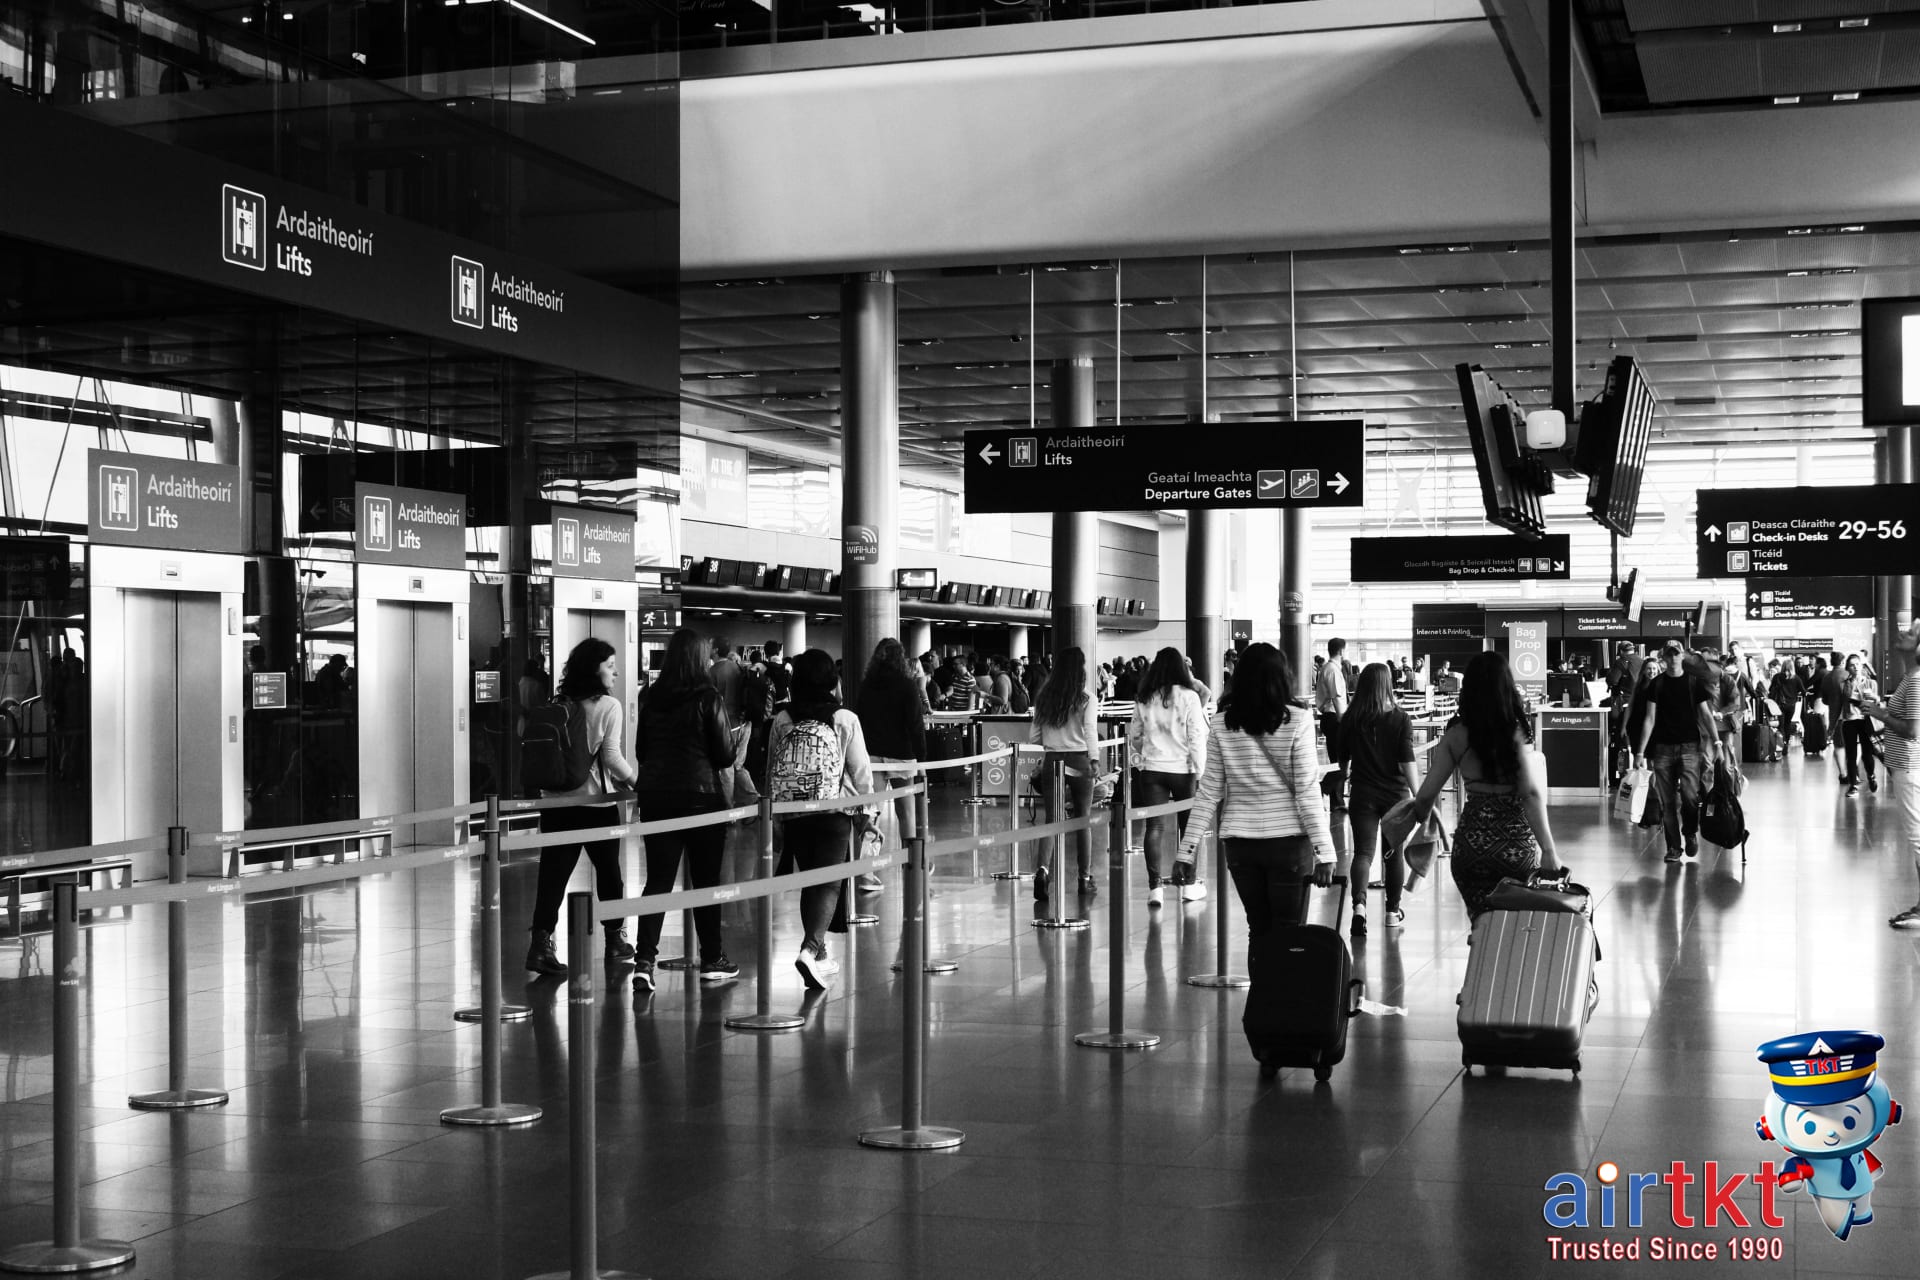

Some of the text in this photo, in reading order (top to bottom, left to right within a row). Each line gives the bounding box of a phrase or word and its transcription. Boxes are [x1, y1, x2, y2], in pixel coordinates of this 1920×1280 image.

[276, 206, 373, 256] Ardaitheoirí
[276, 243, 312, 276] Lifts
[491, 272, 564, 313] Ardaitheoirí
[491, 304, 518, 333] Lifts
[1045, 434, 1126, 449] Ardaitheoirí
[1045, 453, 1073, 466] Lifts
[1147, 470, 1252, 484] Geataí Imeachta
[147, 474, 233, 503] Ardaitheoirí
[1145, 486, 1252, 503] Departure Gates
[147, 505, 179, 529] Lifts
[398, 502, 460, 527] Ardaitheoirí
[1752, 519, 1836, 530] Deasca Cláraithe
[1839, 520, 1907, 539] 29-56
[398, 529, 421, 551] Lifts
[583, 523, 631, 544] Ardaitheoirí
[1752, 532, 1829, 543] Check-in Desks
[583, 546, 602, 565] Lifts
[1752, 549, 1783, 559] Ticéid
[682, 558, 692, 571] 37
[709, 560, 719, 573] 38
[757, 564, 766, 577] 39
[1448, 565, 1516, 575] Bag Drop & Check-in
[1752, 562, 1789, 572] Tickets
[1819, 605, 1855, 617] 29-56
[1516, 627, 1536, 639] Bag
[1514, 639, 1541, 651] Drop
[1562, 716, 1582, 724] Lingus
